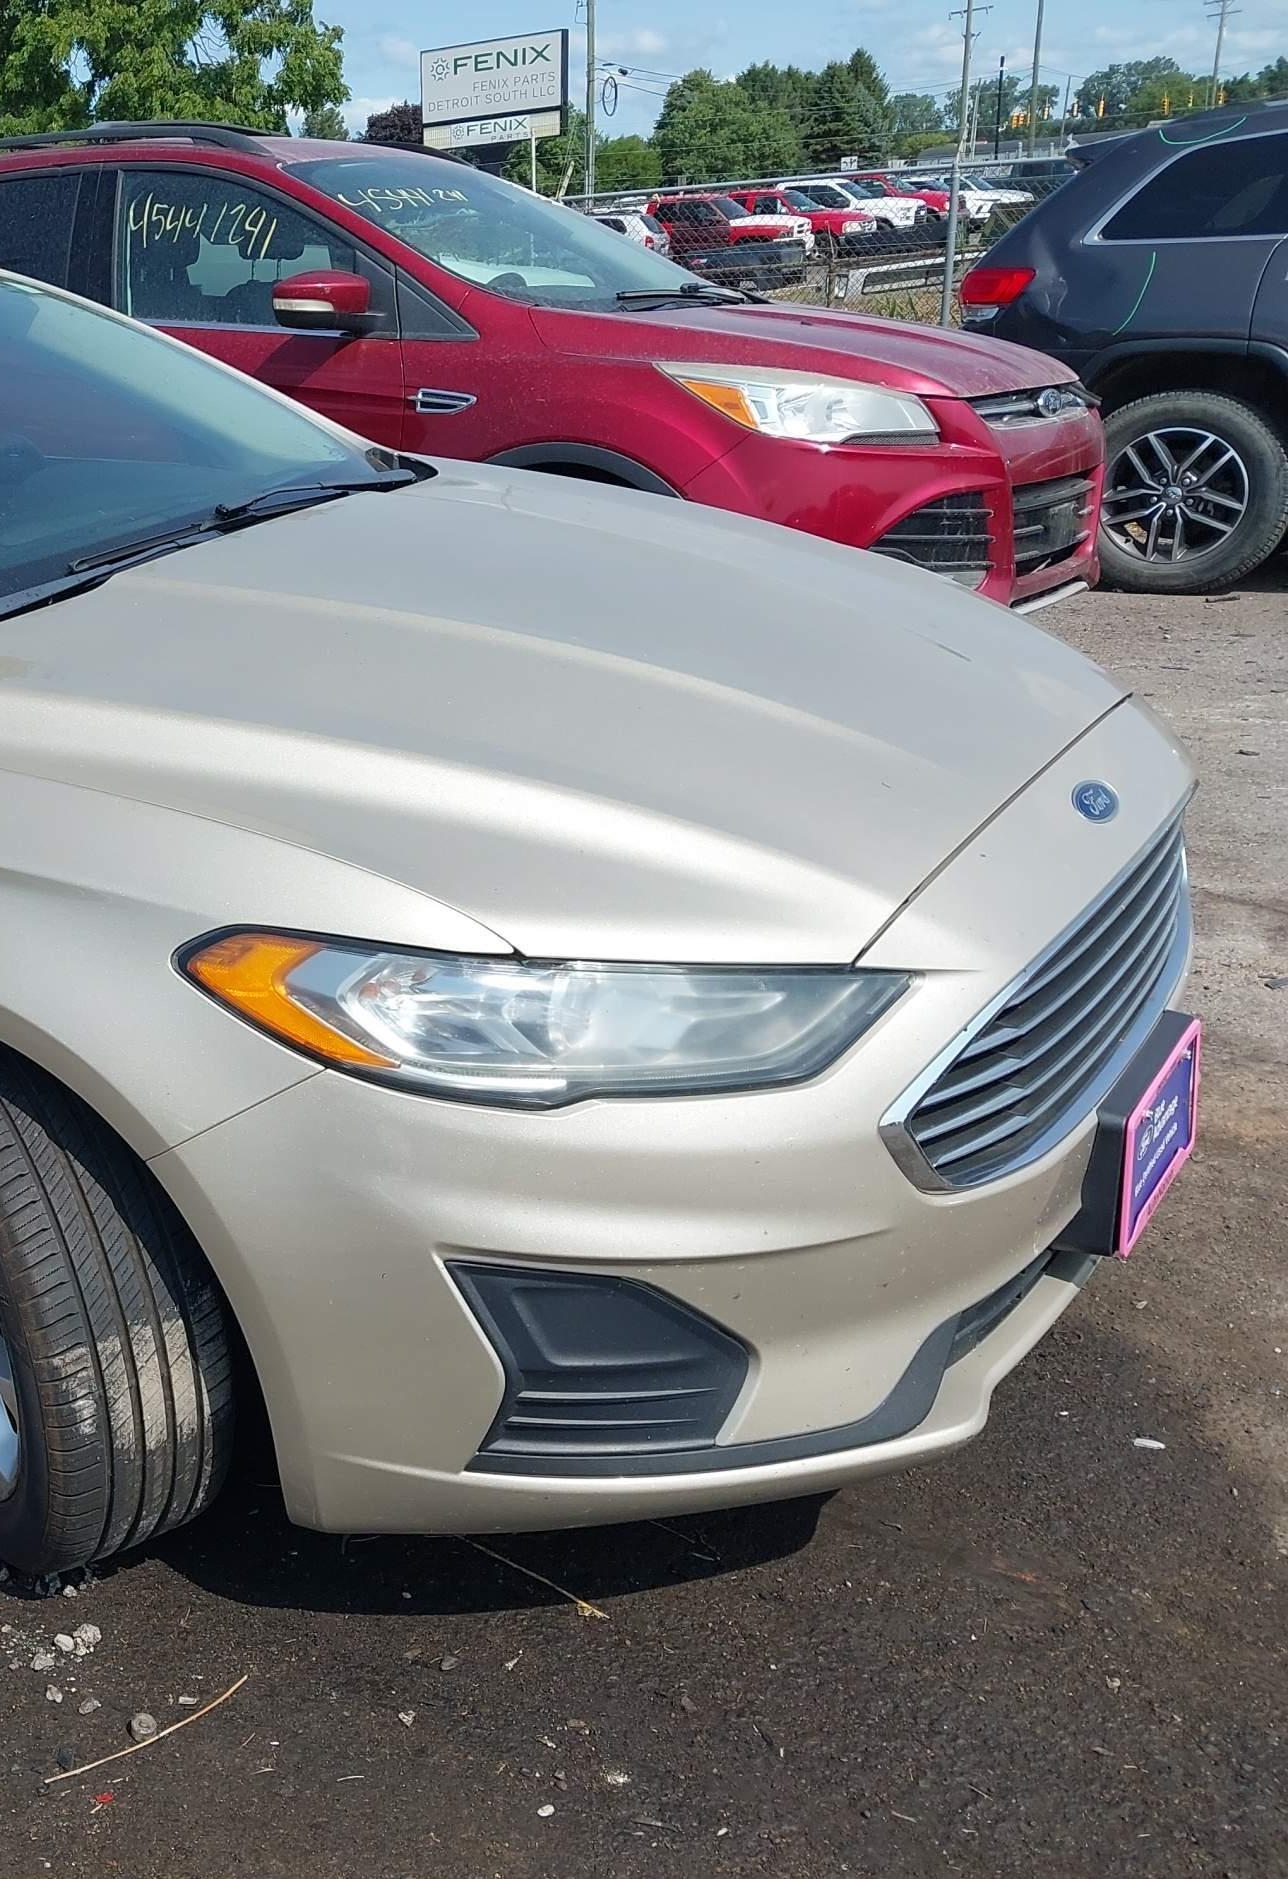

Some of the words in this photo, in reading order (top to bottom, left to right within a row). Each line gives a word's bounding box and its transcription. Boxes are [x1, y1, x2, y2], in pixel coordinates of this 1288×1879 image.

[453, 44, 551, 75] FENIX
[473, 78, 508, 92] FENIX
[514, 71, 555, 87] PARTS
[428, 95, 480, 112] DETROIT
[485, 90, 528, 104] SOUTH
[532, 85, 556, 98] LLC
[466, 117, 528, 137] FENIX
[490, 131, 529, 142] PARTS
